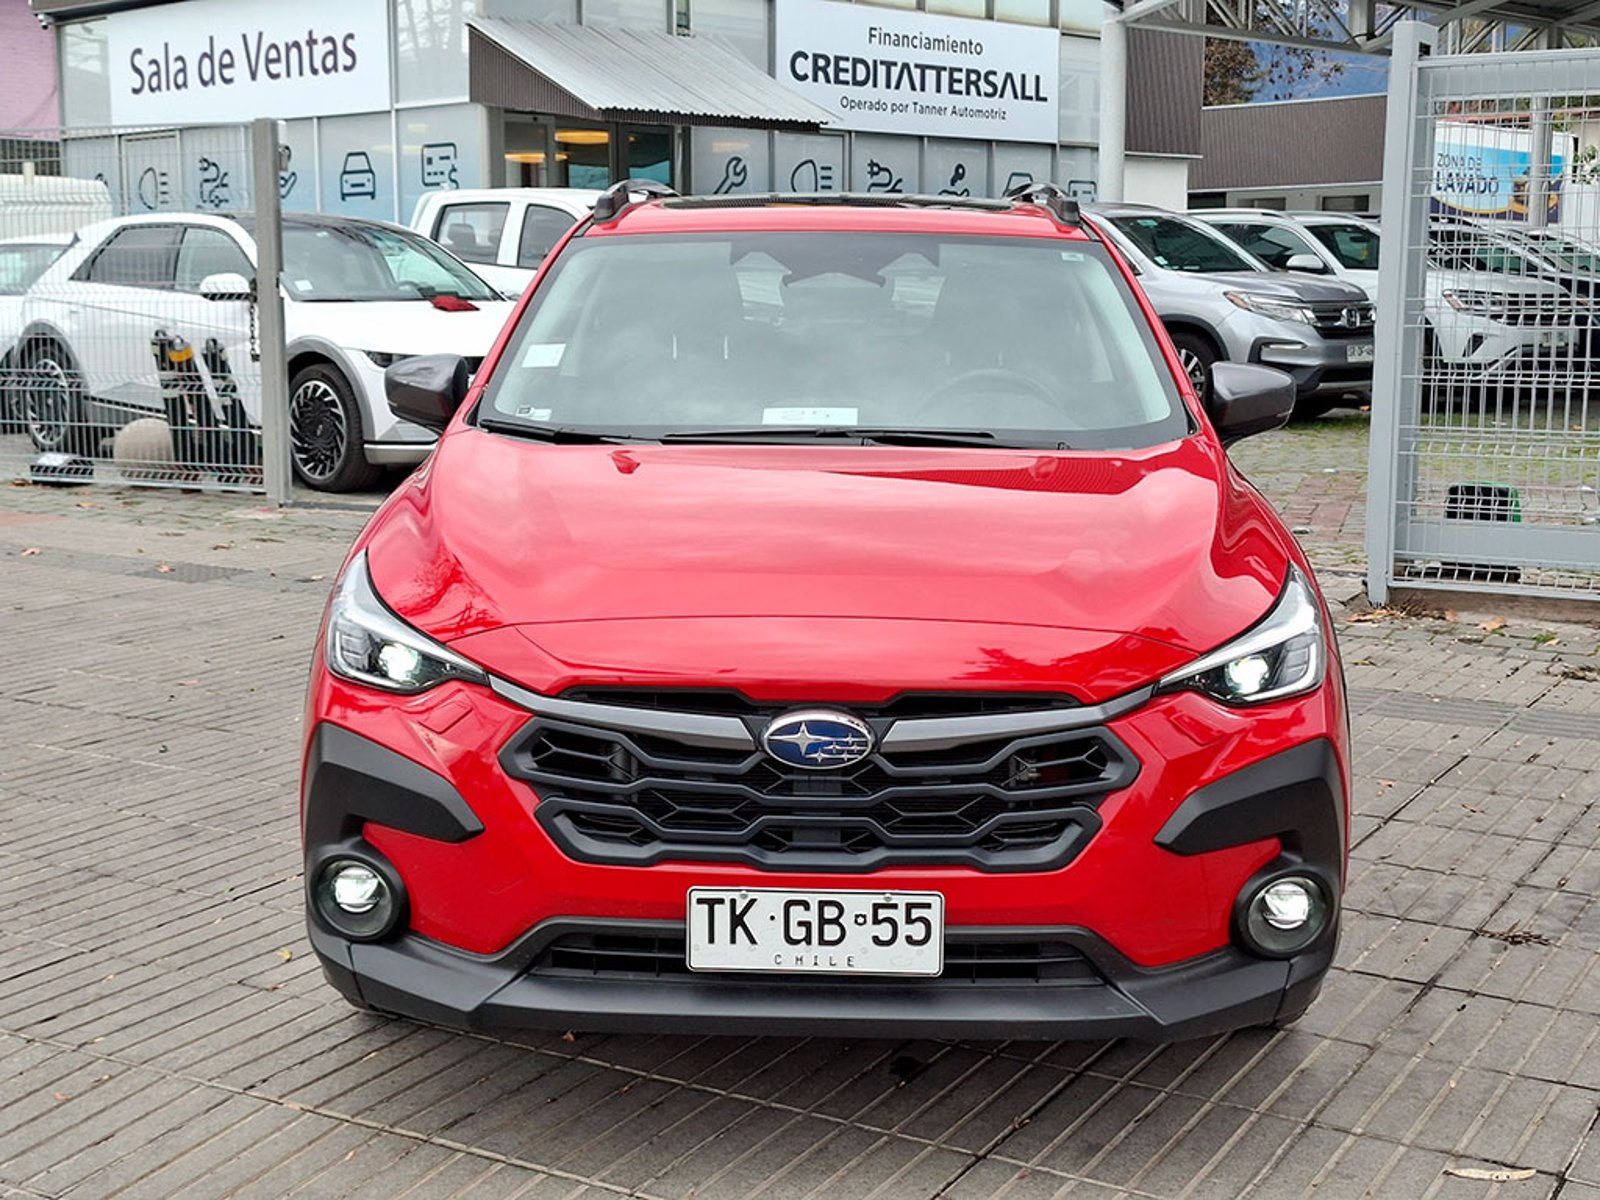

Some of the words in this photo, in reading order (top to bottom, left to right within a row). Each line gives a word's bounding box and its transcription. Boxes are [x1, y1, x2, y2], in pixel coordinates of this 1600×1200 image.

[868, 27, 984, 56] Financiamiento
[130, 42, 189, 95] Sala
[197, 35, 236, 88] de
[241, 29, 358, 83] Ventas
[789, 50, 1048, 103] CREDITATTERSALL
[839, 95, 889, 113] Operado
[890, 102, 910, 115] por
[912, 101, 948, 117] Tanner
[949, 104, 1007, 121] Automotriz
[1436, 170, 1500, 196] LAVADO
[774, 954, 855, 968] CHILE
